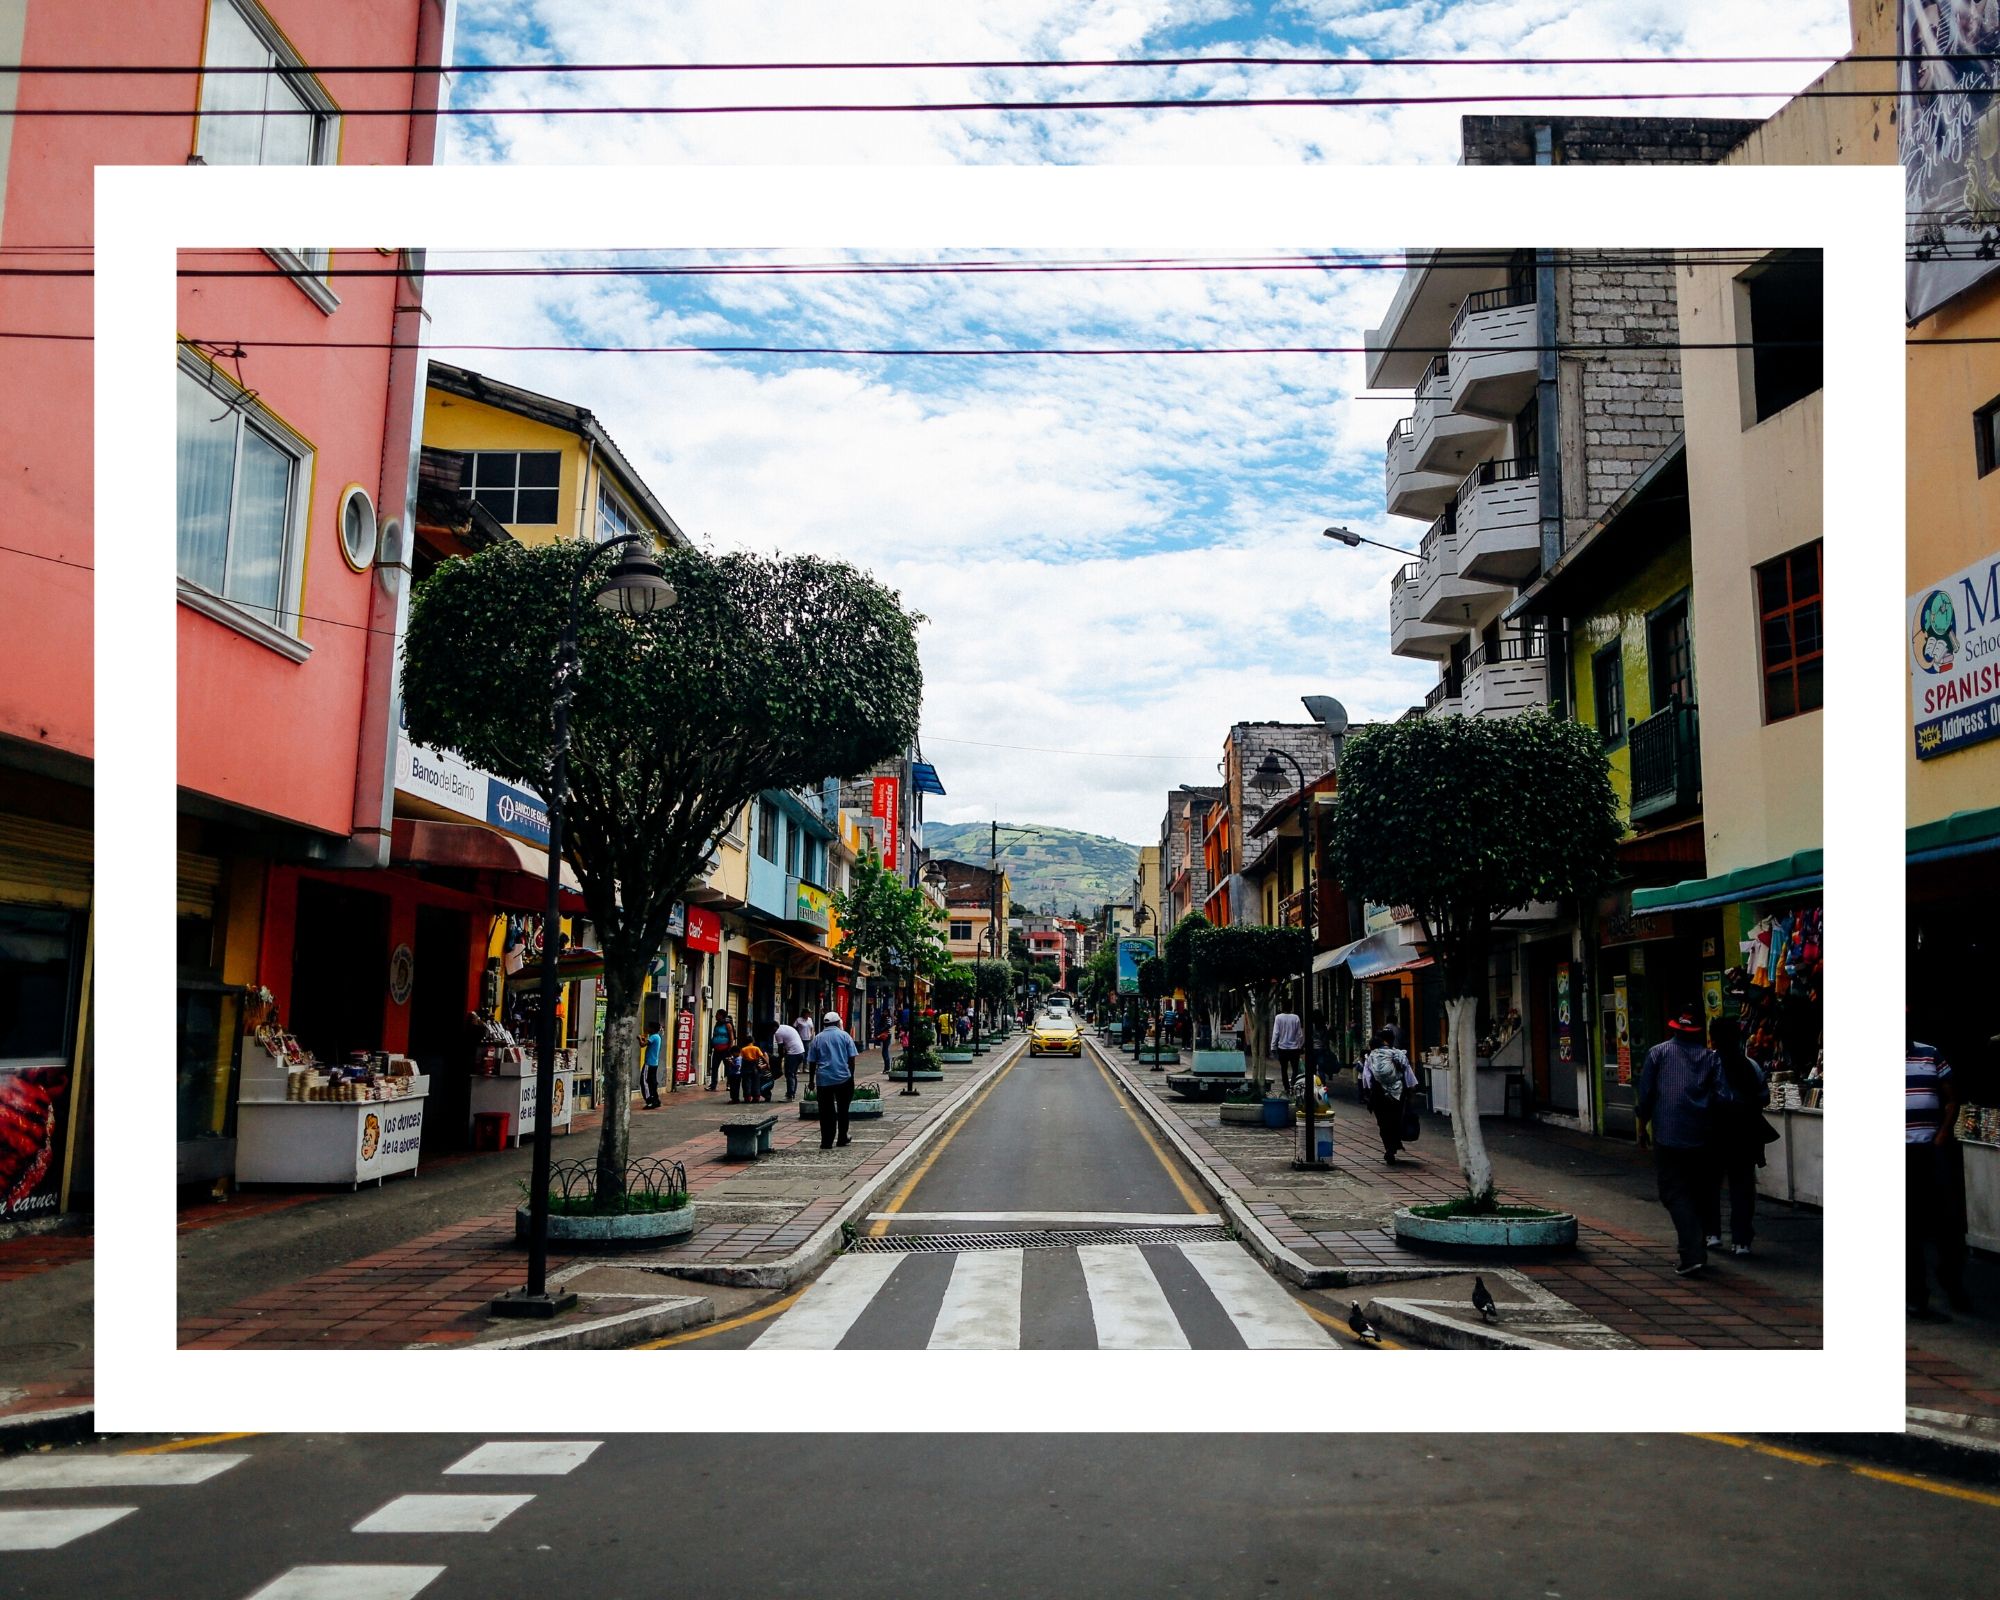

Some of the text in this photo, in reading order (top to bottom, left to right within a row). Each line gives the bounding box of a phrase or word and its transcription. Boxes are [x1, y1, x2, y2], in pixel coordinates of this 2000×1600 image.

[1921, 733, 1938, 745] NEW
[1942, 709, 1988, 742] Address:
[412, 756, 439, 787] Banco
[439, 769, 452, 792] del
[452, 774, 475, 801] Barrio
[514, 801, 531, 817] BANCO
[530, 807, 537, 820] DE
[676, 1016, 691, 1072] CABINAS
[384, 1111, 422, 1134] los dulces
[382, 1136, 420, 1155] de la abuela
[13, 1191, 58, 1213] carnes
